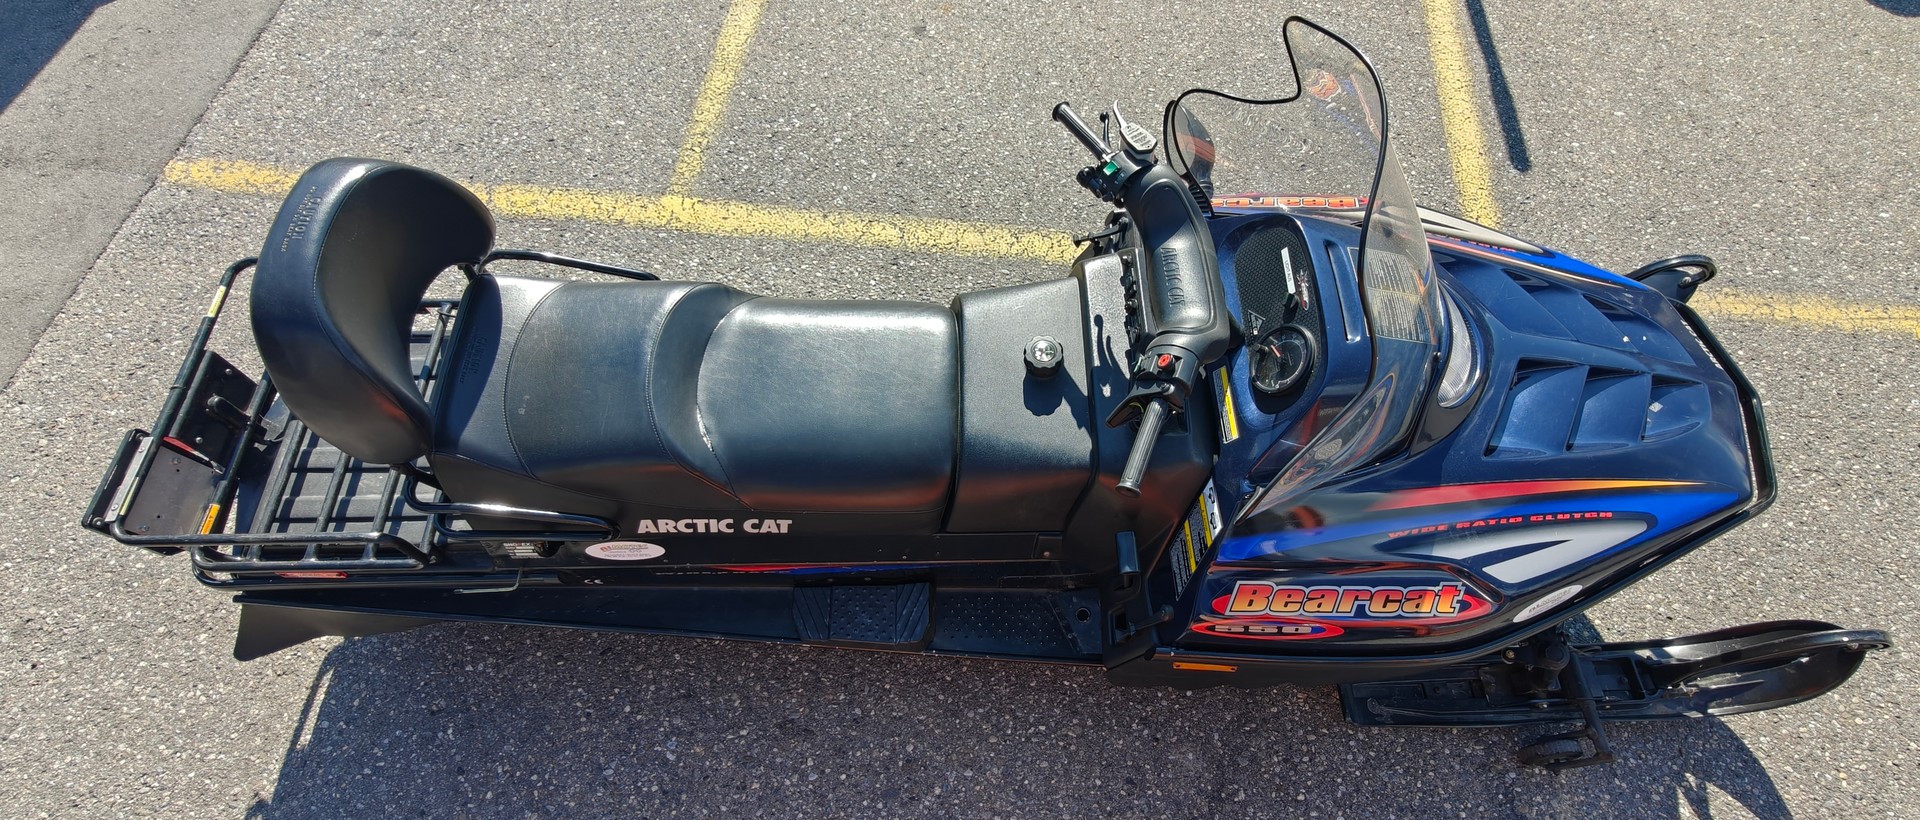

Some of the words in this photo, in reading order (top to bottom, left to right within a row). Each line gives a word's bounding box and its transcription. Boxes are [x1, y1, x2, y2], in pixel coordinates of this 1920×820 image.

[292, 197, 322, 240] CAUTION
[1160, 248, 1182, 286] ARCTIC
[1167, 288, 1186, 308] CAT
[637, 518, 735, 534] ARCTIC
[742, 518, 793, 534] CAT
[1387, 524, 1449, 539] WIDE
[1455, 516, 1523, 529] RATIO
[1529, 511, 1614, 522] CLUTCH
[1225, 580, 1465, 617] Bearcat
[1214, 624, 1313, 634] 550
